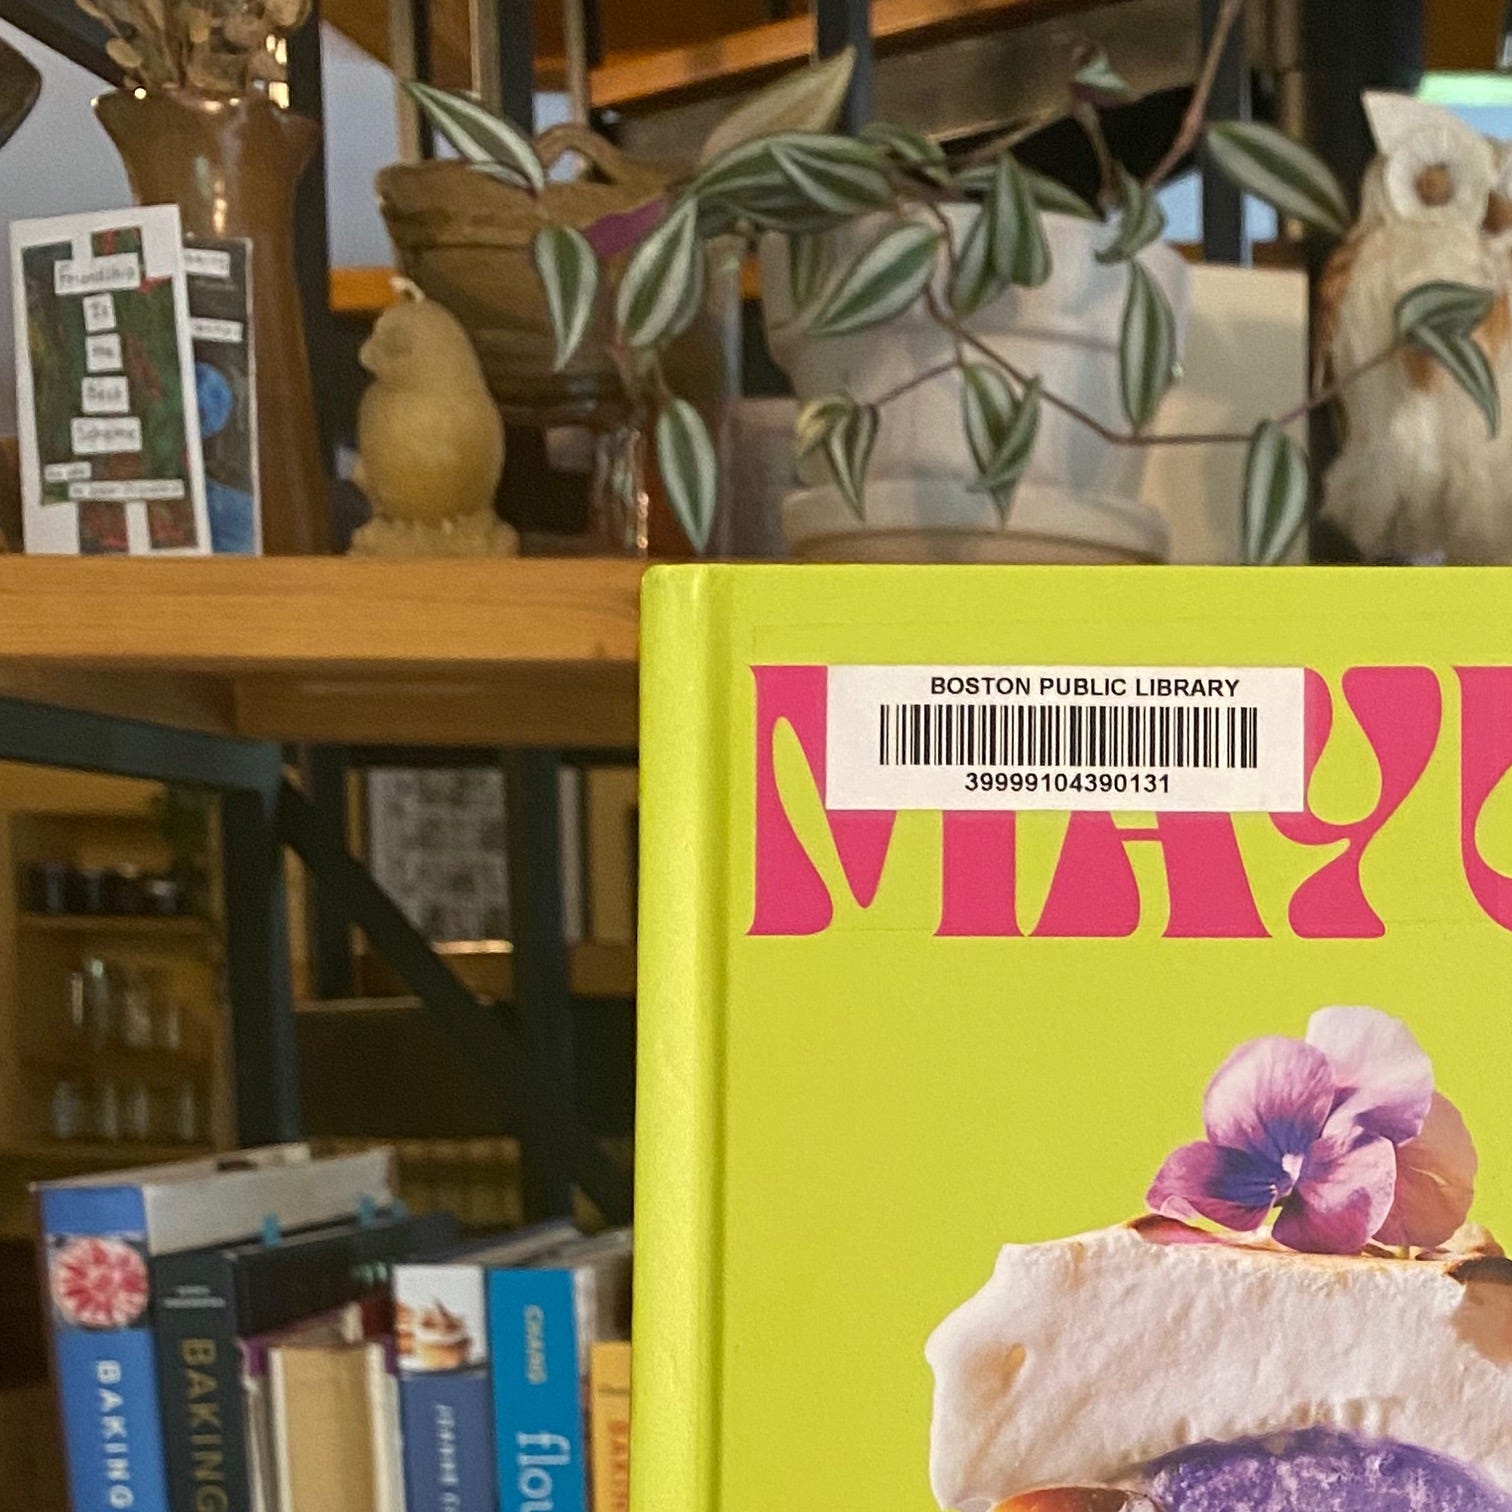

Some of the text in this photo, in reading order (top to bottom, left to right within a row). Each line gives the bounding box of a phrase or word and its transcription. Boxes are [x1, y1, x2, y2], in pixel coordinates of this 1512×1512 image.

[931, 676, 1240, 698] BOSTON PUBLIC LIBRARY
[964, 773, 1171, 794] 39999104390131
[95, 1359, 135, 1511] BAKING
